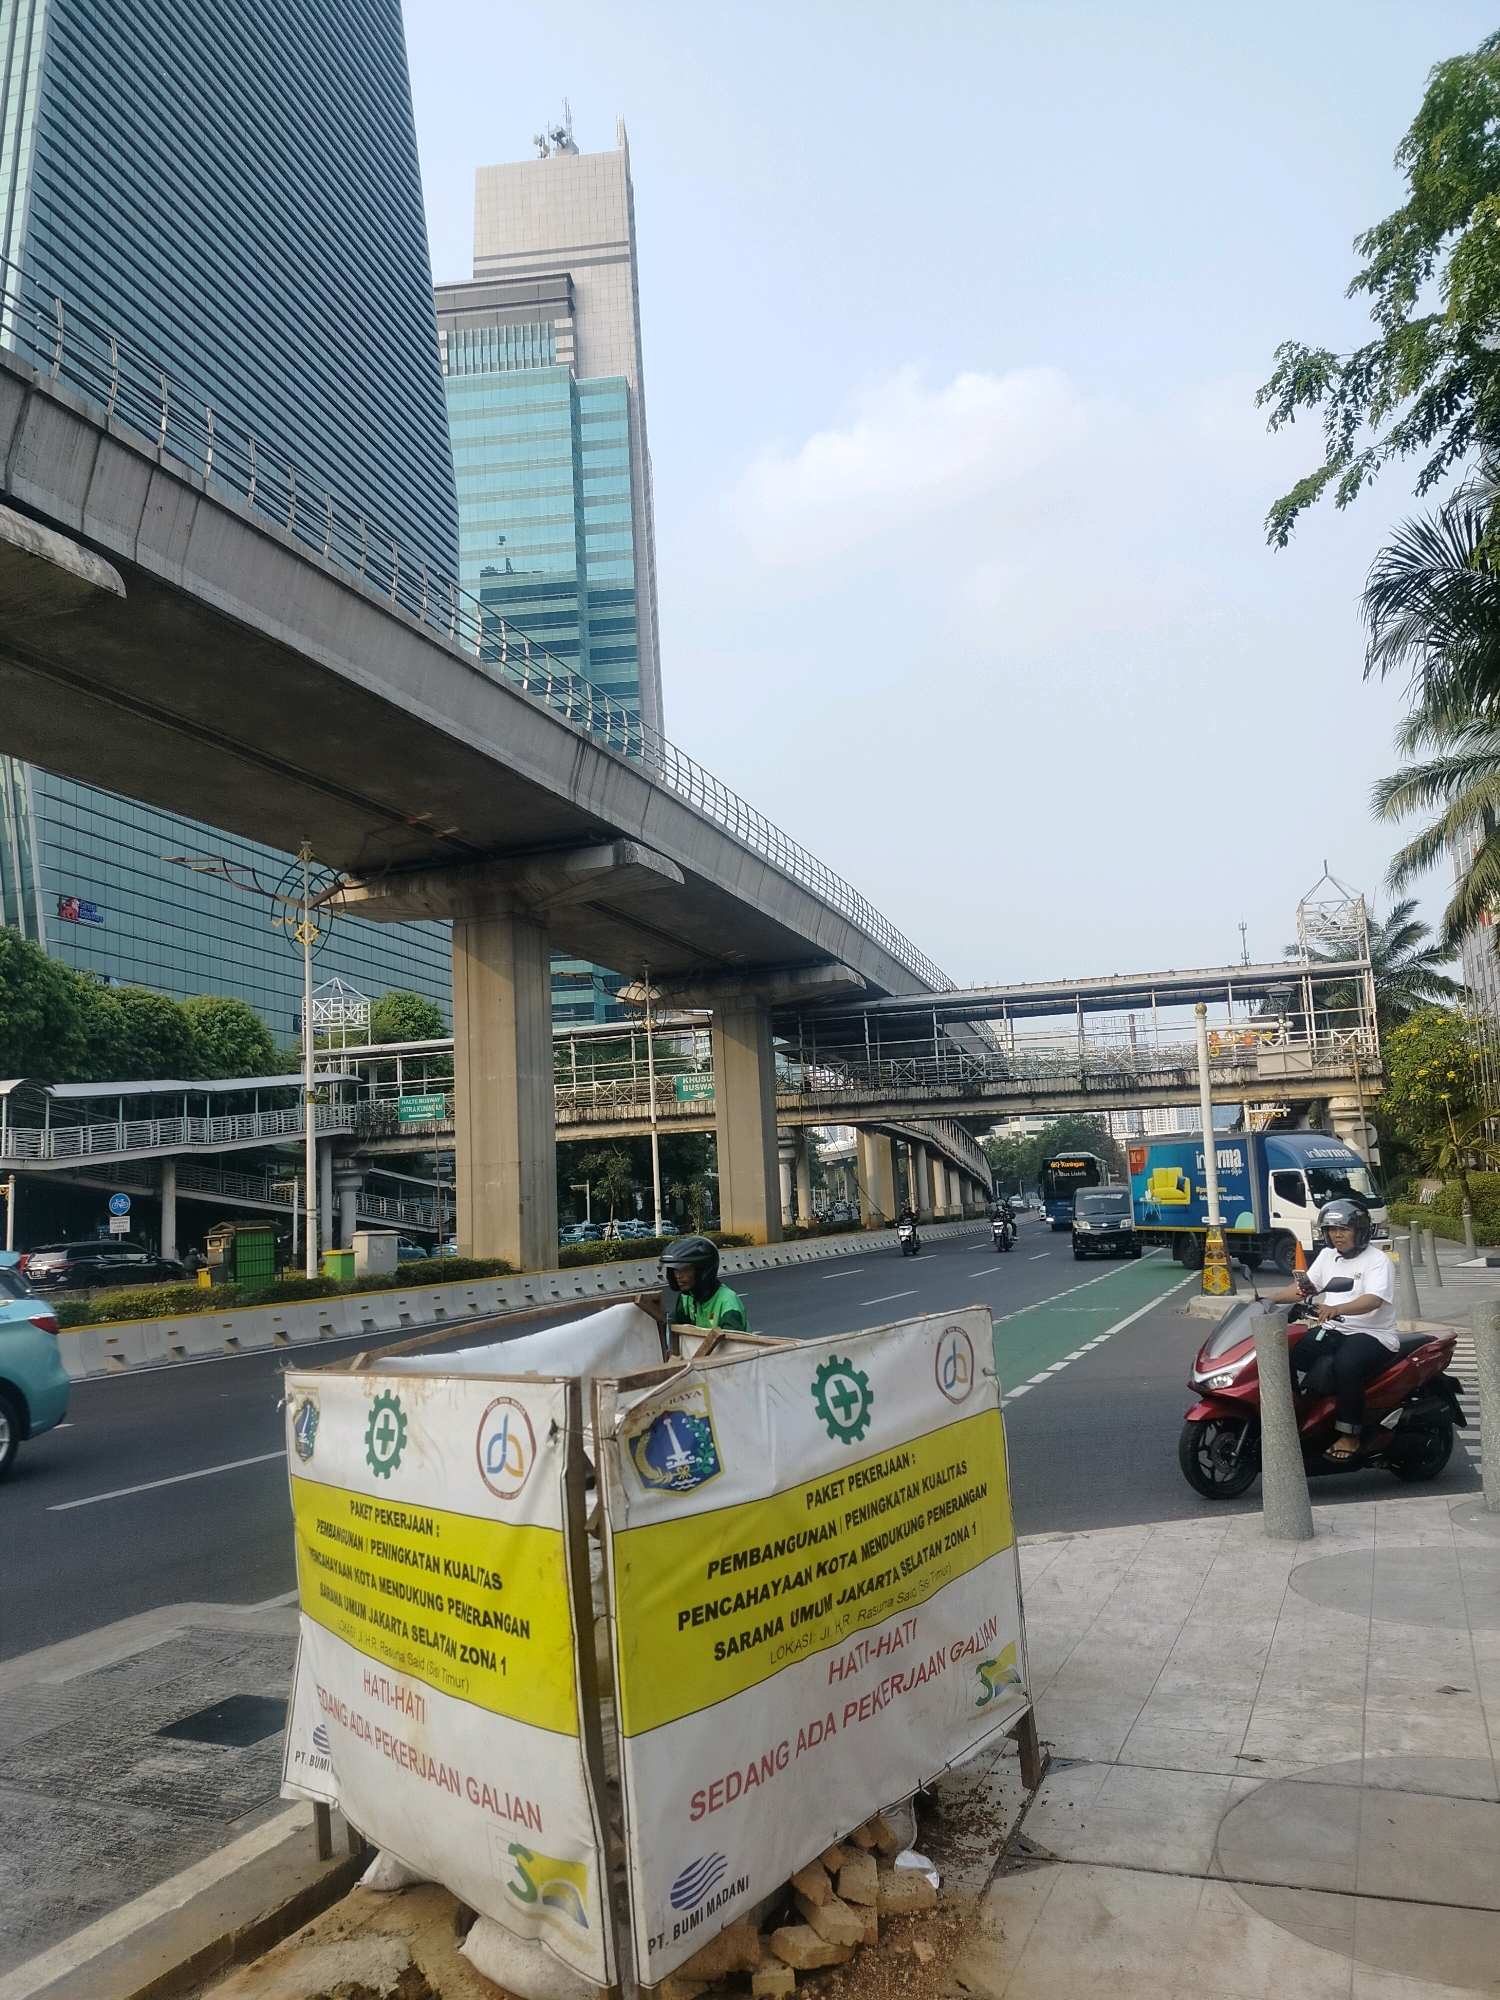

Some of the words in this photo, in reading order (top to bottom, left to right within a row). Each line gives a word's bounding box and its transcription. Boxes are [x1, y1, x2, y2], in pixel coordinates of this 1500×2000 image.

[419, 1096, 441, 1104] BUSWAY
[806, 1478, 845, 1511] PAKET
[848, 1452, 910, 1492] PEKERJAAN
[316, 1518, 363, 1553] PEMBANGUNAN
[370, 1538, 440, 1575] PENINGKATAN
[444, 1558, 503, 1591] KUALITAS
[350, 1500, 373, 1522] PAKET
[375, 1507, 433, 1537] PEKERJAAN
[707, 1519, 838, 1580] PEMBANGUNAN
[845, 1481, 920, 1531] PENINGKATAN
[921, 1460, 968, 1494] KUALITAS
[678, 1565, 813, 1632] PENCAHAYAAN
[816, 1550, 858, 1579] KOTA
[861, 1514, 925, 1562] MENDUKUNG
[926, 1482, 987, 1526] PENERANGAN
[714, 1616, 785, 1662] SARANA
[790, 1593, 833, 1628] UMUM
[836, 1566, 900, 1606] JAKARTA
[900, 1539, 942, 1577] SELATAN
[944, 1525, 970, 1552] ZONA
[972, 1521, 977, 1536] 1
[320, 1581, 343, 1609] SARANA
[344, 1595, 367, 1621] UMUM
[368, 1607, 409, 1640] JAKARTA
[411, 1624, 457, 1660] SELATAN
[460, 1643, 497, 1673] ZONA
[501, 1656, 506, 1676] 1
[354, 1567, 378, 1592] KOTA
[379, 1576, 444, 1613] MENDUKUNG
[447, 1598, 530, 1640] PENERANGAN
[770, 1632, 816, 1666] LOKASI:
[857, 1598, 894, 1623] Rasuna
[897, 1586, 917, 1604] Said
[407, 1652, 425, 1671] Said
[441, 1667, 469, 1694] Timur)
[828, 1617, 918, 1685] HATI-HATI
[363, 1668, 425, 1724] HATI-HATI
[689, 1740, 790, 1822] SEDANG
[796, 1711, 837, 1758] ADA
[842, 1647, 947, 1729] PEKERJAAN
[950, 1615, 998, 1663] GALIAN
[309, 1754, 330, 1772] BUMI
[350, 1710, 373, 1746] ADA
[374, 1726, 462, 1797] PEKERJAAN
[466, 1776, 543, 1834] GALIAN
[647, 1932, 669, 1956] PT.
[673, 1907, 704, 1941] BUMI
[706, 1874, 750, 1917] MADANI
